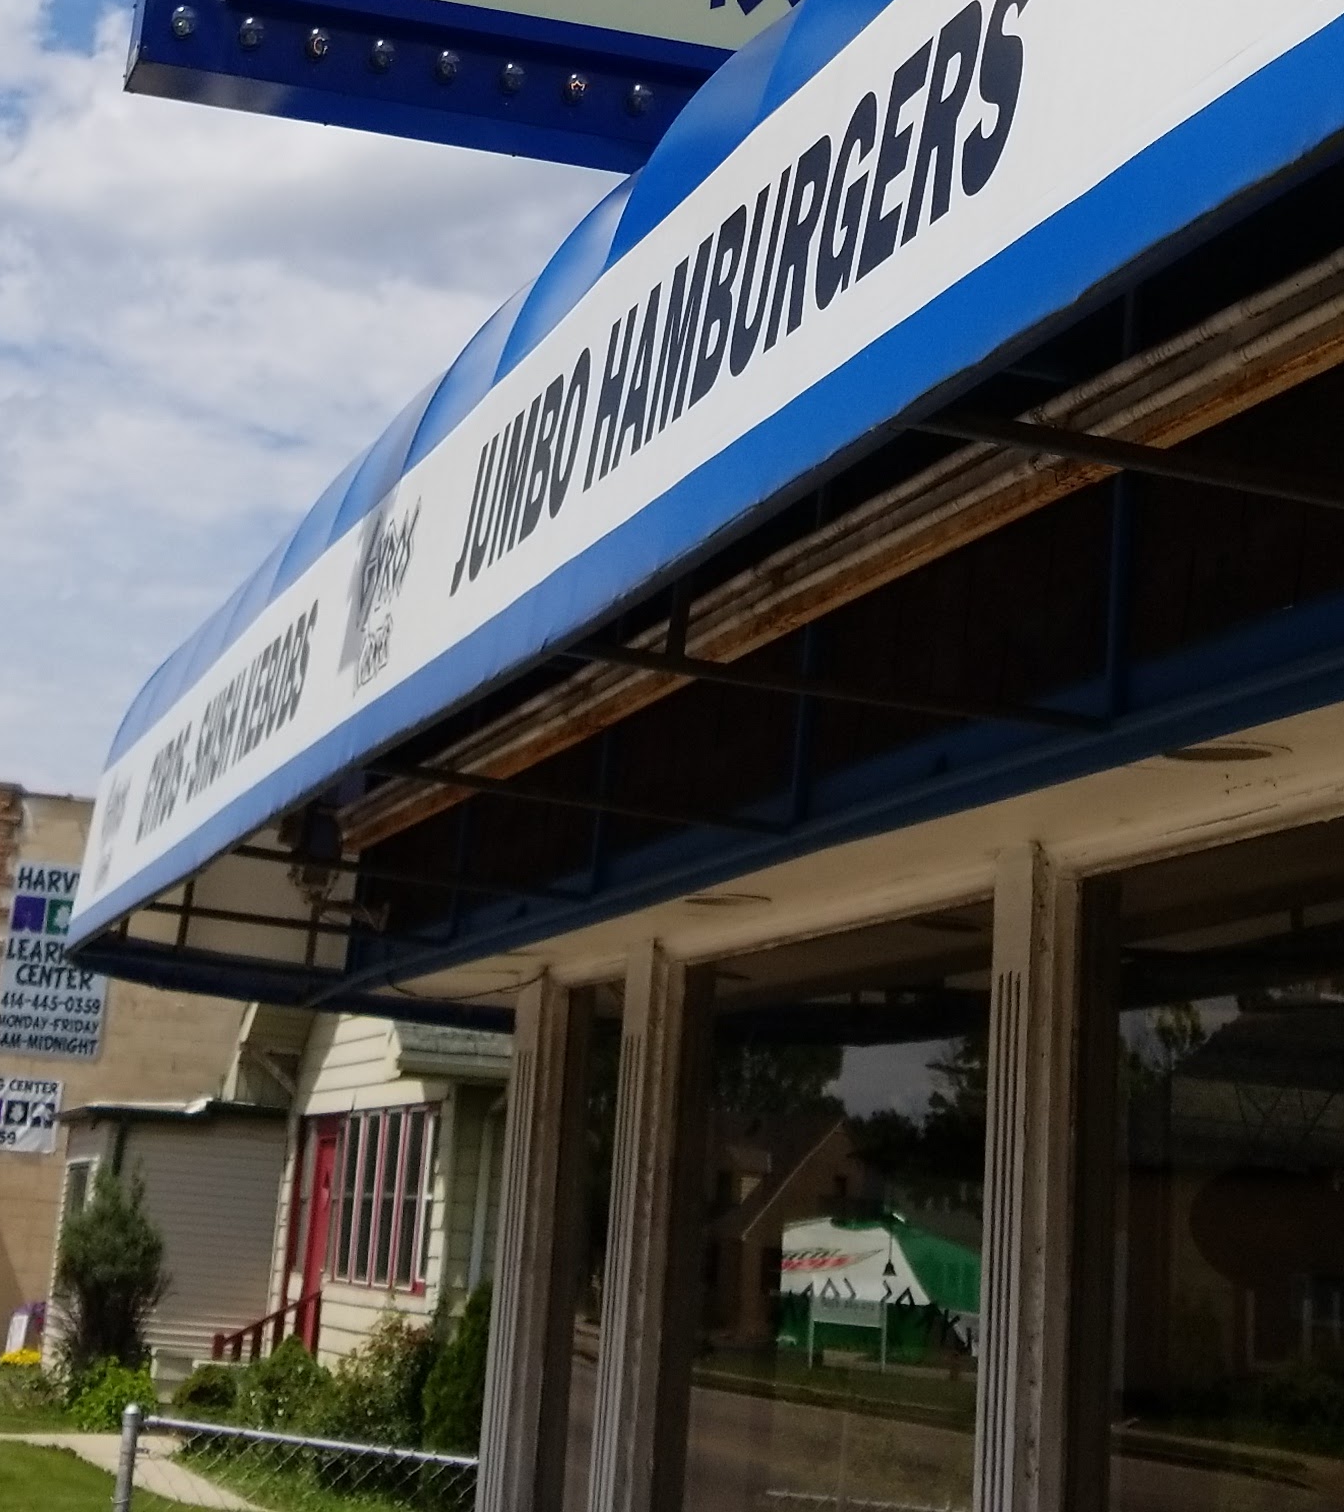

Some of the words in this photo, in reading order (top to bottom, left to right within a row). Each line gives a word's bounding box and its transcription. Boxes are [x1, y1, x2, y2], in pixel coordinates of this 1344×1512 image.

[450, 348, 590, 597] JUMBO
[232, 599, 318, 766] KEBOBS
[18, 867, 80, 892] HARV
[16, 963, 95, 991] CENTER
[1, 992, 101, 1015] 414-445-0359
[9, 1079, 58, 1094] CENTER
